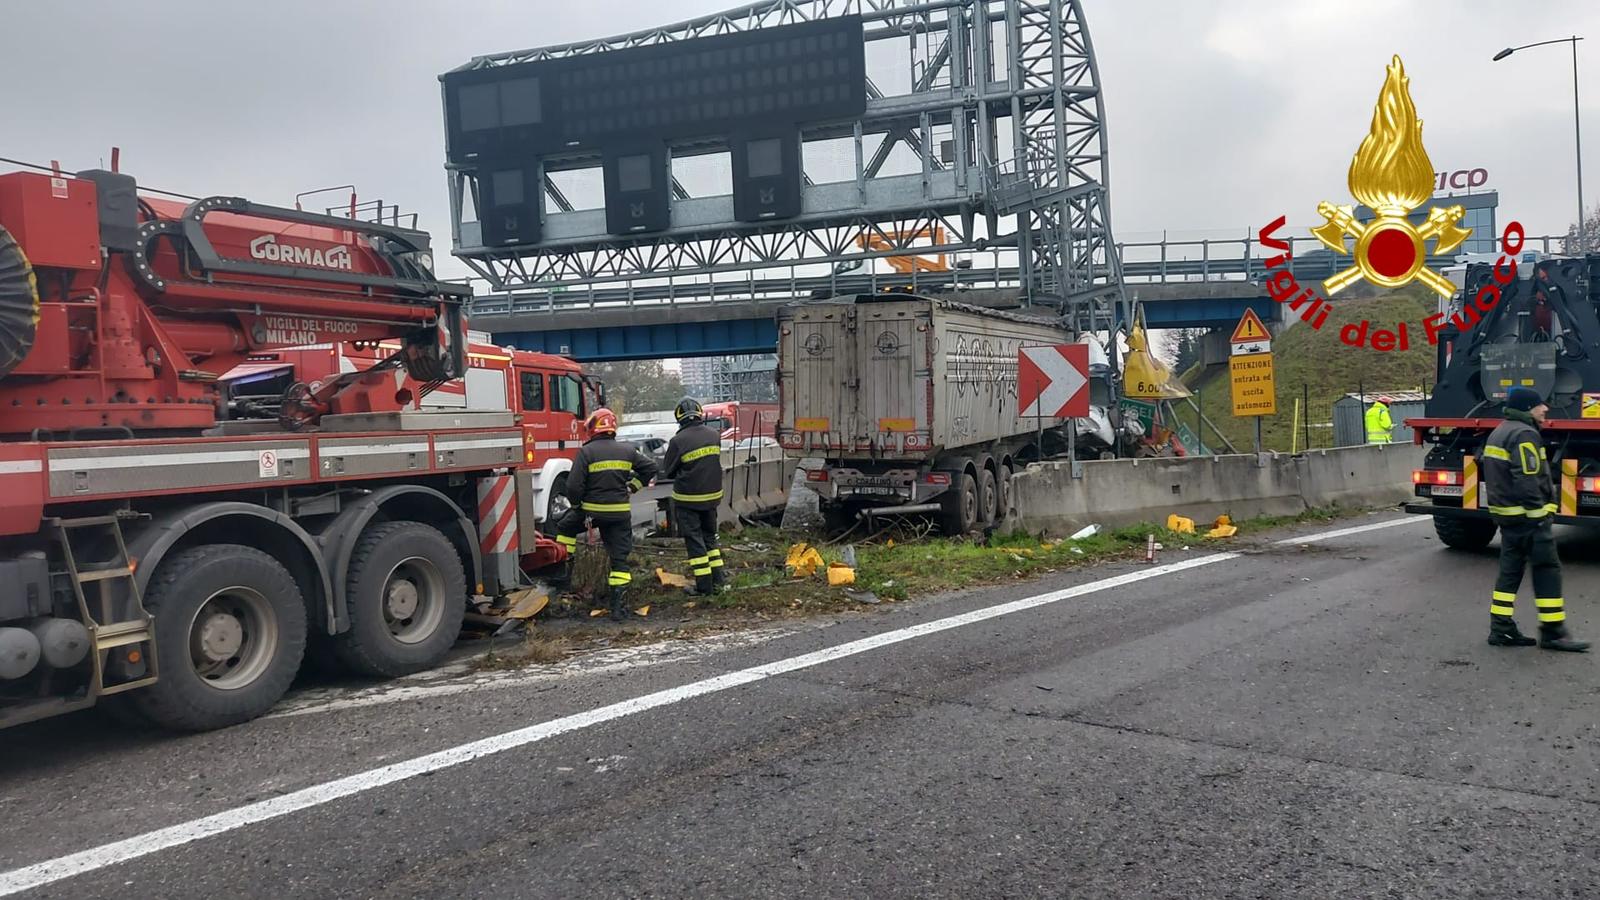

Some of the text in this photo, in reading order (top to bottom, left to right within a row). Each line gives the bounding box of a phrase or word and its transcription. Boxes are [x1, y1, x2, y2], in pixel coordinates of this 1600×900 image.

[1434, 168, 1488, 190] ICO
[266, 317, 358, 333] VIGILI DEL FUOCO
[266, 329, 317, 344] MILANO
[1232, 360, 1271, 370] ATTENZIONE
[1234, 373, 1271, 383] entrata ed
[1242, 388, 1264, 396] uscita
[1237, 401, 1272, 410] automezzi
